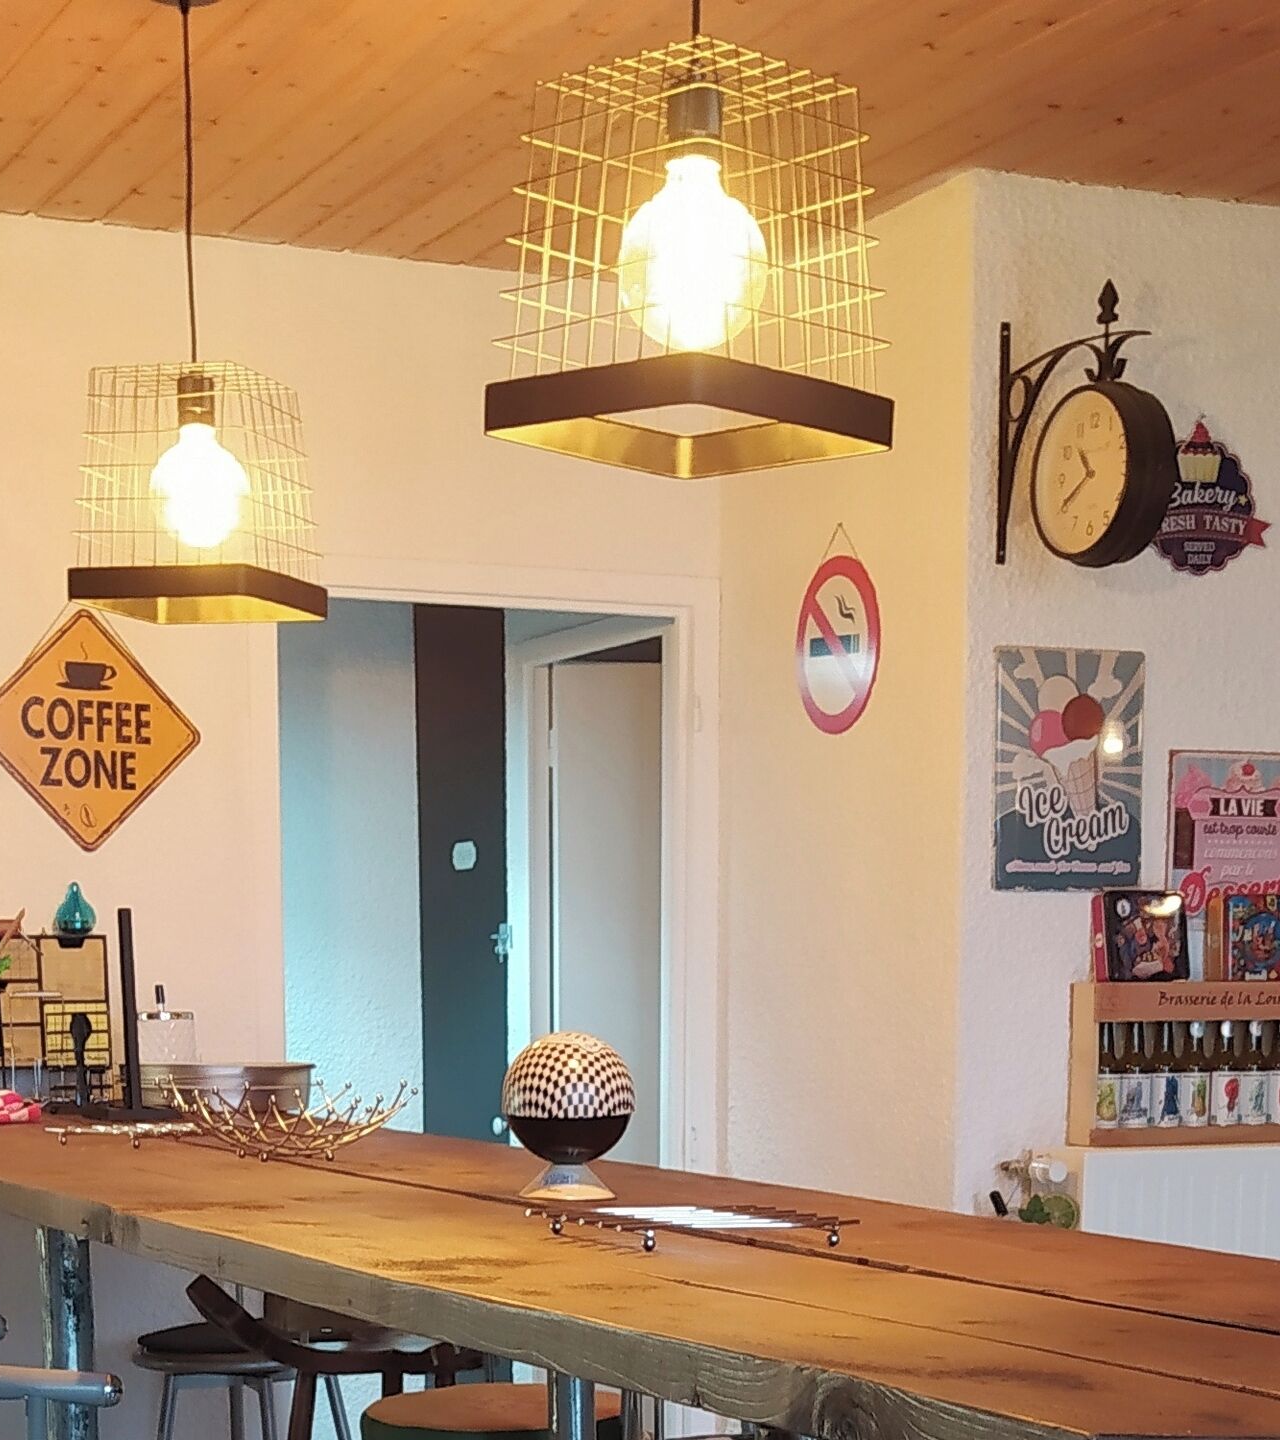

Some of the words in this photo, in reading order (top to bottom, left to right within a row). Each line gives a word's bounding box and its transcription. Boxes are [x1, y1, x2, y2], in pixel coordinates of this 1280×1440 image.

[1161, 514, 1196, 533] RESH
[1203, 515, 1247, 536] TASTY
[20, 695, 152, 746] COFFEE
[39, 746, 137, 791] ZONE
[1018, 785, 1066, 824] Ice
[1219, 798, 1238, 816] LA
[1240, 798, 1265, 816] VIE
[1046, 804, 1129, 856] Cream
[1158, 990, 1217, 1006] Brasserie
[1220, 990, 1234, 1010] de
[1237, 991, 1252, 1006] la
